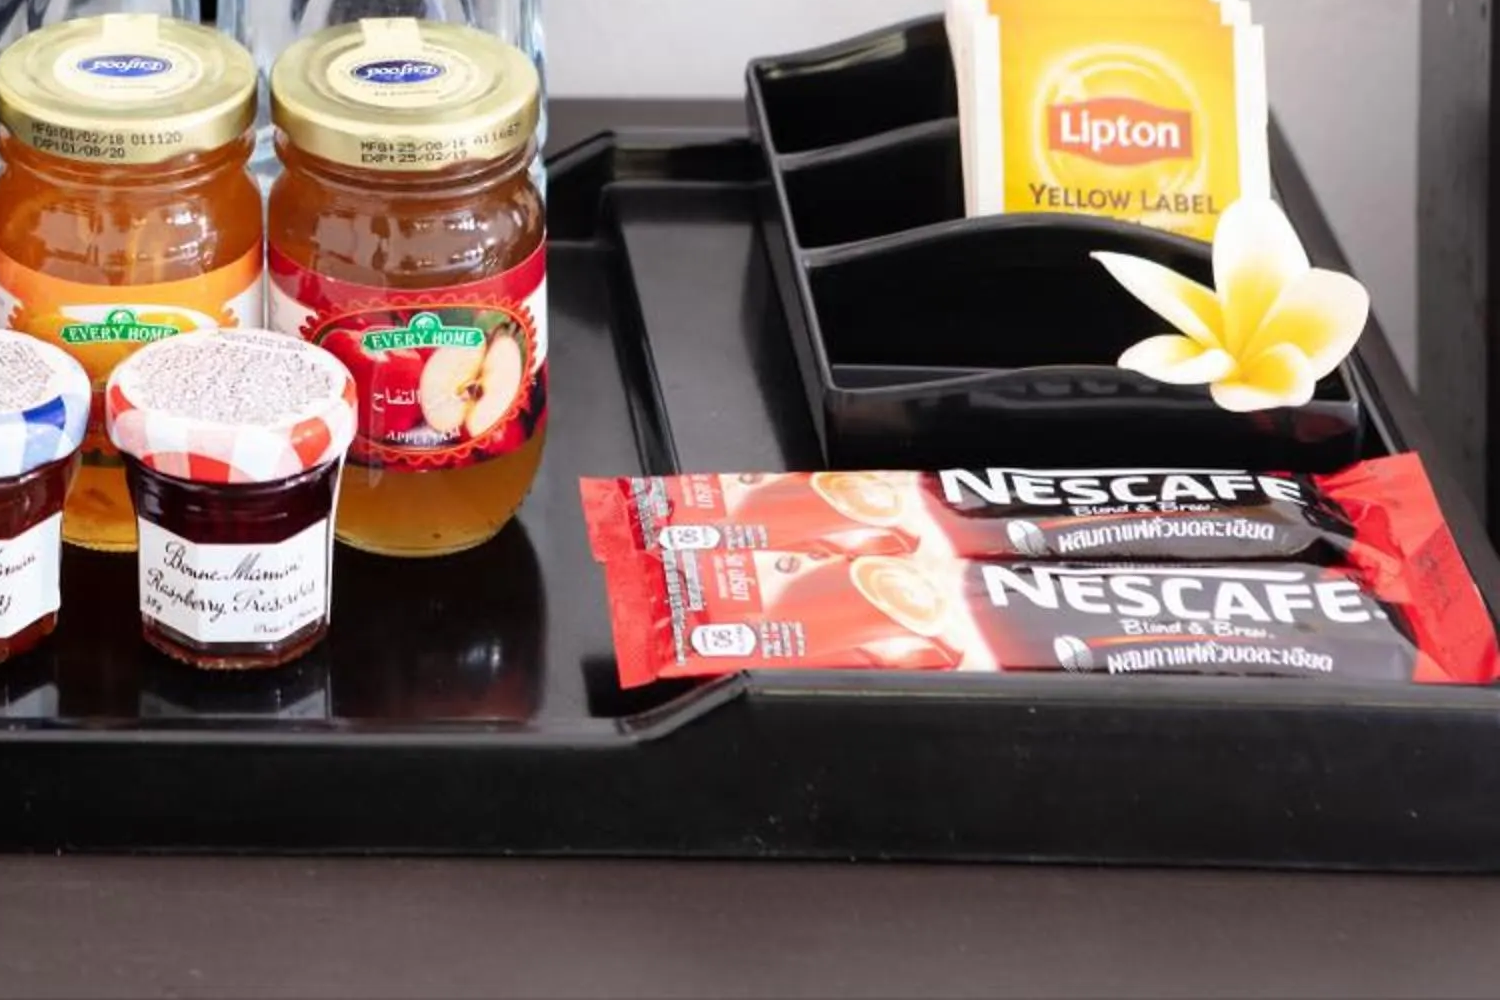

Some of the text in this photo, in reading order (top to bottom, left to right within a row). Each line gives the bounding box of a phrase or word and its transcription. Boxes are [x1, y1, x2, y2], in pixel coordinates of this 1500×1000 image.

[1059, 110, 1181, 153] Lipton
[1029, 183, 1220, 214] YELLOW LABEL
[69, 326, 175, 341] EVERY HOME
[372, 331, 477, 348] EVERY HOME
[146, 566, 227, 623] Raspberry
